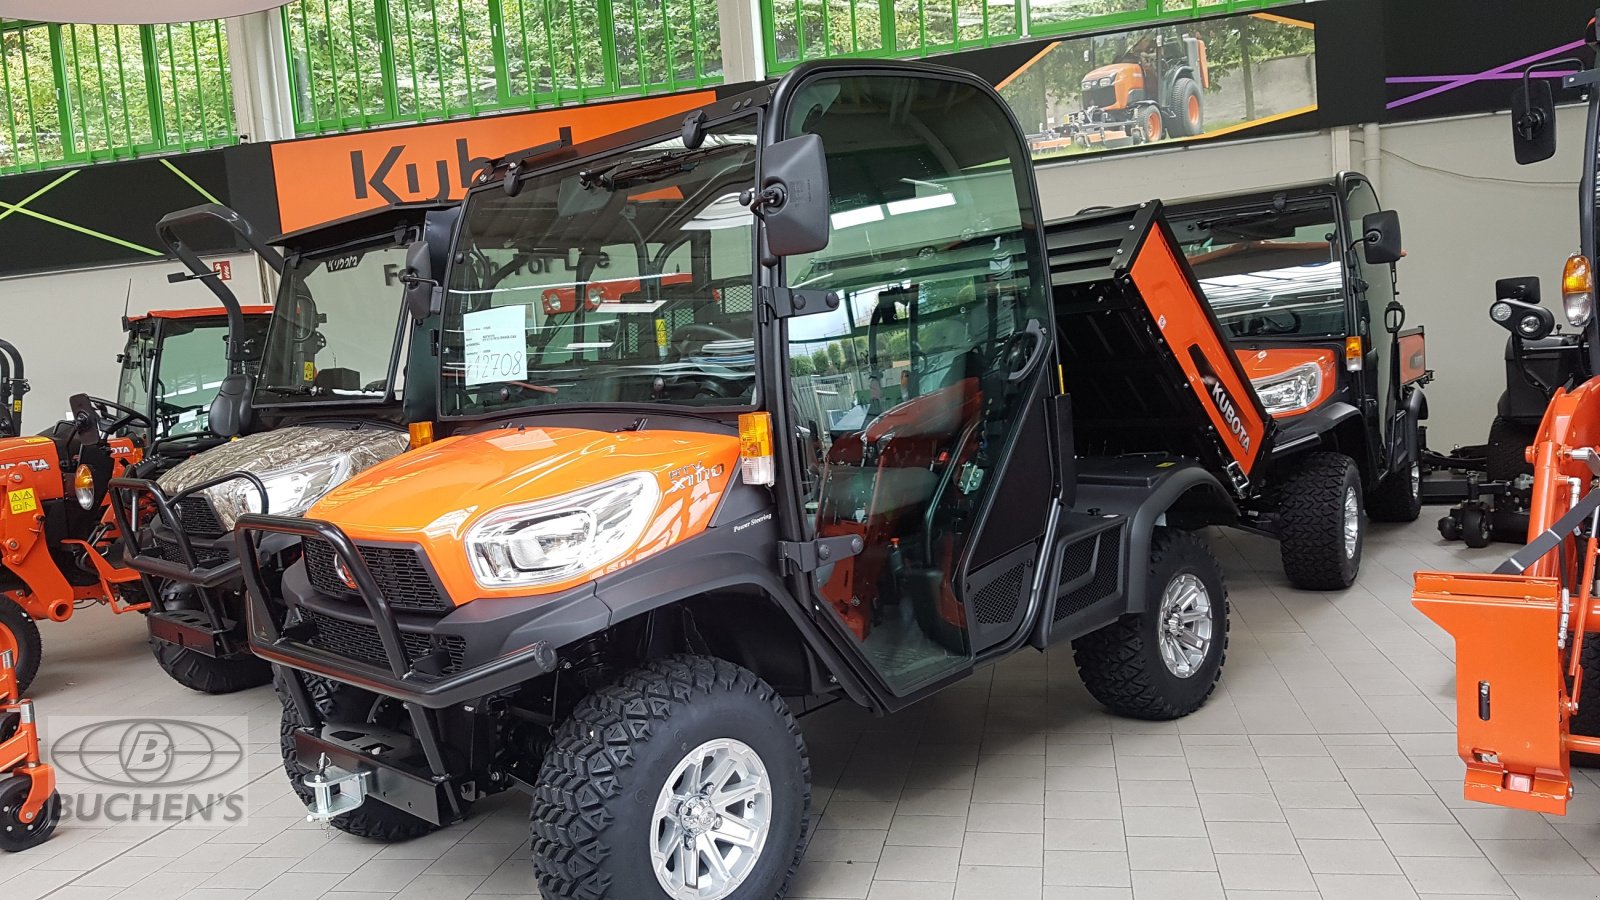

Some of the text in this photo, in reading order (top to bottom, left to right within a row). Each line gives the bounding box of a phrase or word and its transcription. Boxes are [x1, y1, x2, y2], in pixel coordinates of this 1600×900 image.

[350, 126, 572, 206] Kub
[1212, 381, 1250, 454] KUBOTA
[110, 446, 130, 454] OTA
[733, 513, 772, 533] Power Steering
